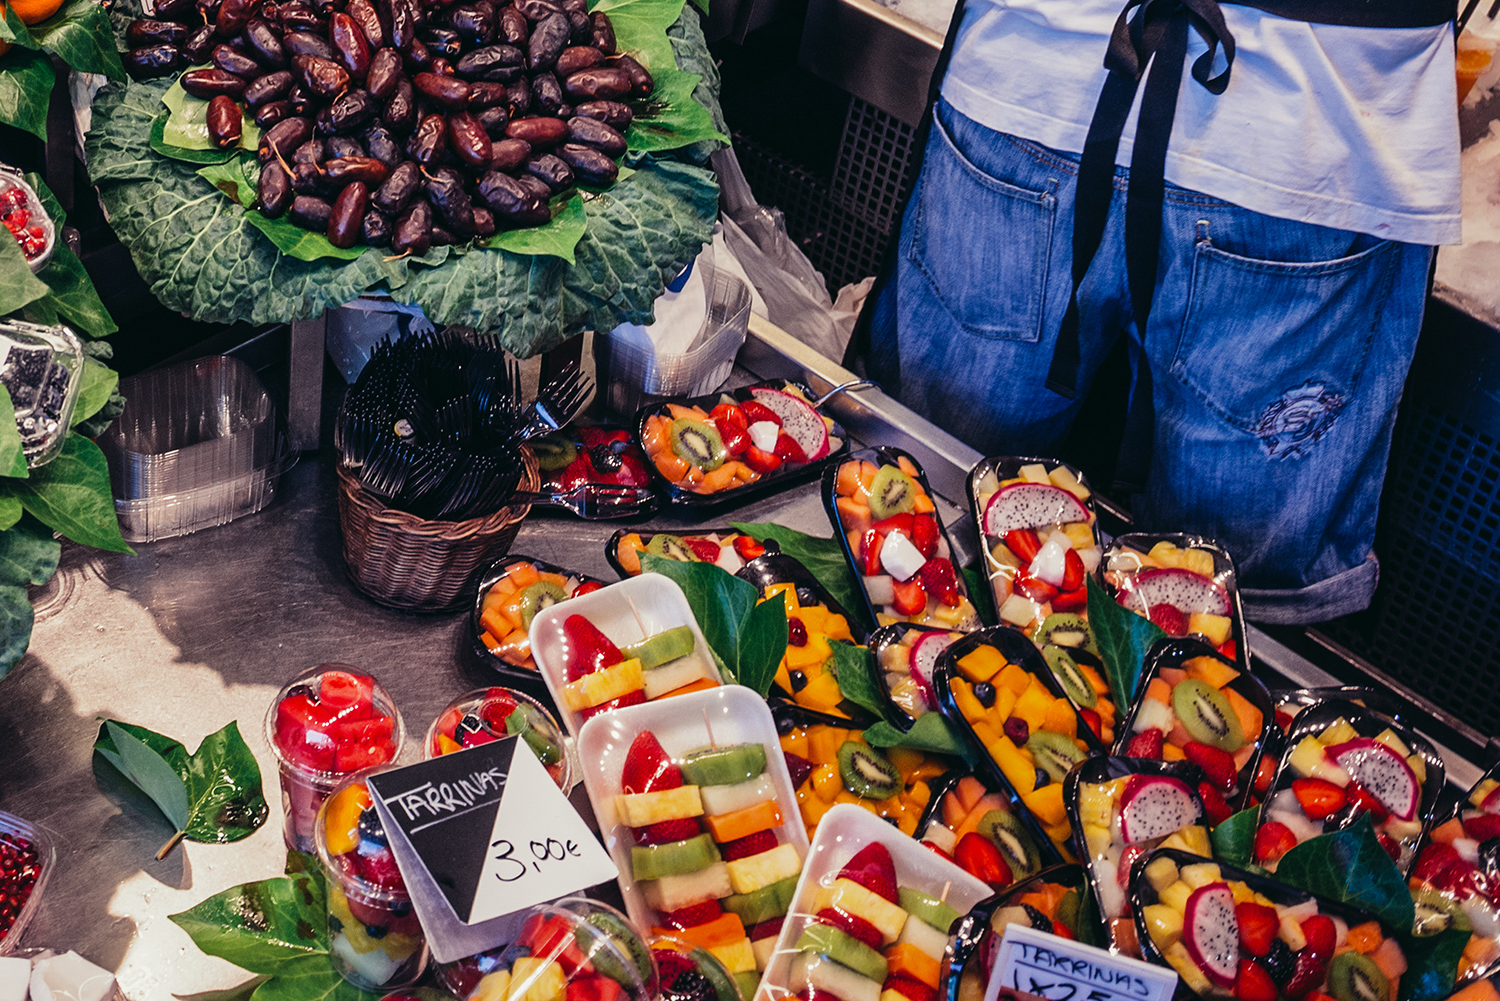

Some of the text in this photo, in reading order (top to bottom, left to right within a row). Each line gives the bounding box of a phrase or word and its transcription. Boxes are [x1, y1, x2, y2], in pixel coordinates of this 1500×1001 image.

[383, 767, 509, 822] TARRINAS
[490, 836, 583, 883] 3,00€
[1007, 939, 1150, 997] TARRINAS
